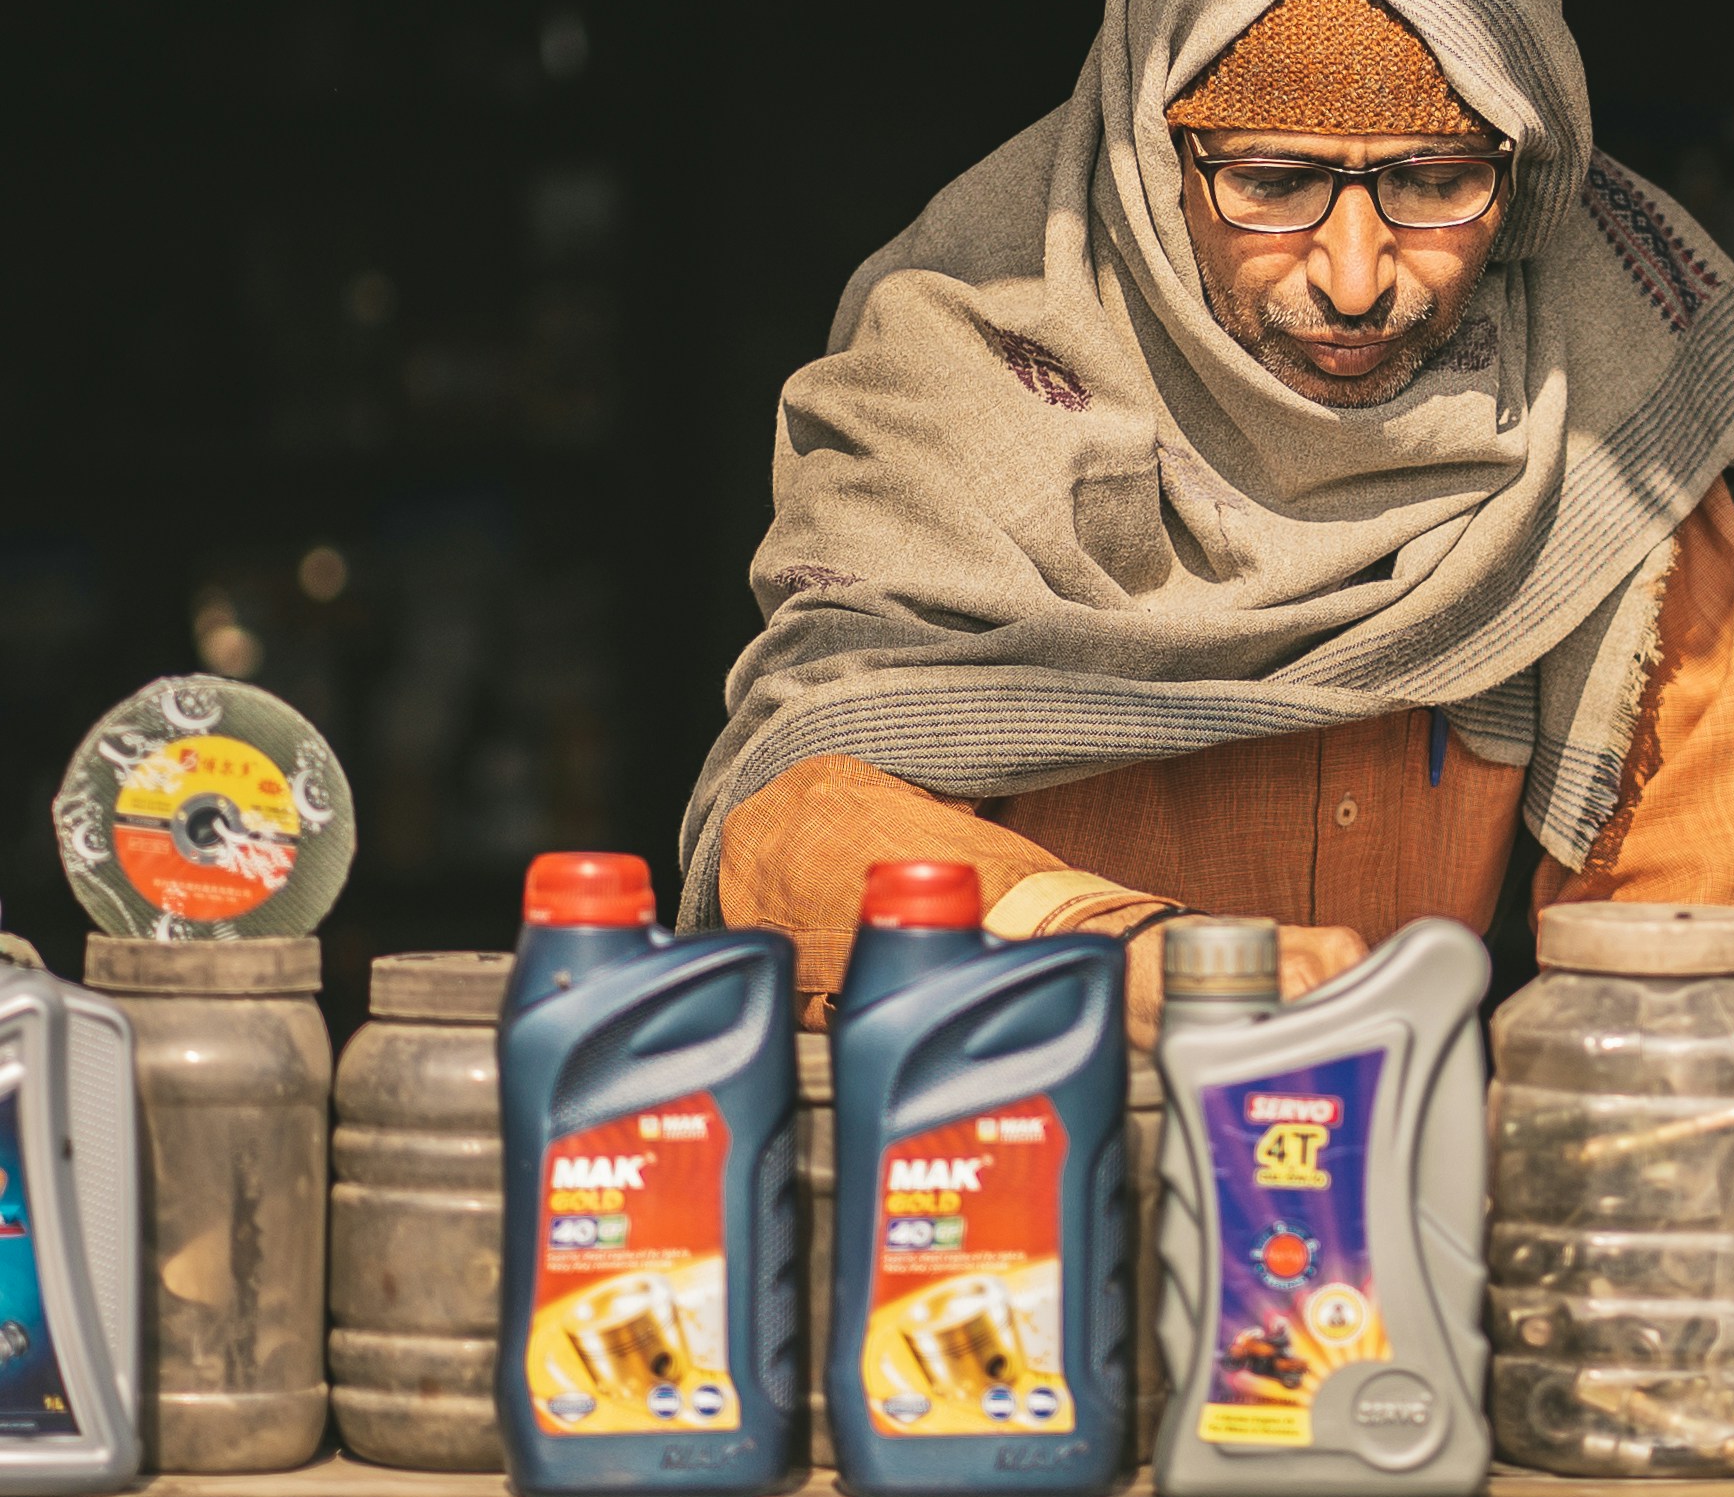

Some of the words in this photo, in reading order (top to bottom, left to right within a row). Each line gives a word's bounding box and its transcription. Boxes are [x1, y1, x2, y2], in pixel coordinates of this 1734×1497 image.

[1251, 1096, 1333, 1122] SERVO
[1267, 1132, 1318, 1166] 4T
[553, 1157, 644, 1189] MAK
[889, 1159, 981, 1191] MAK
[550, 1189, 625, 1212] GOLD
[886, 1191, 961, 1214] GOLD
[552, 1220, 596, 1245] 40
[888, 1221, 933, 1247] 40
